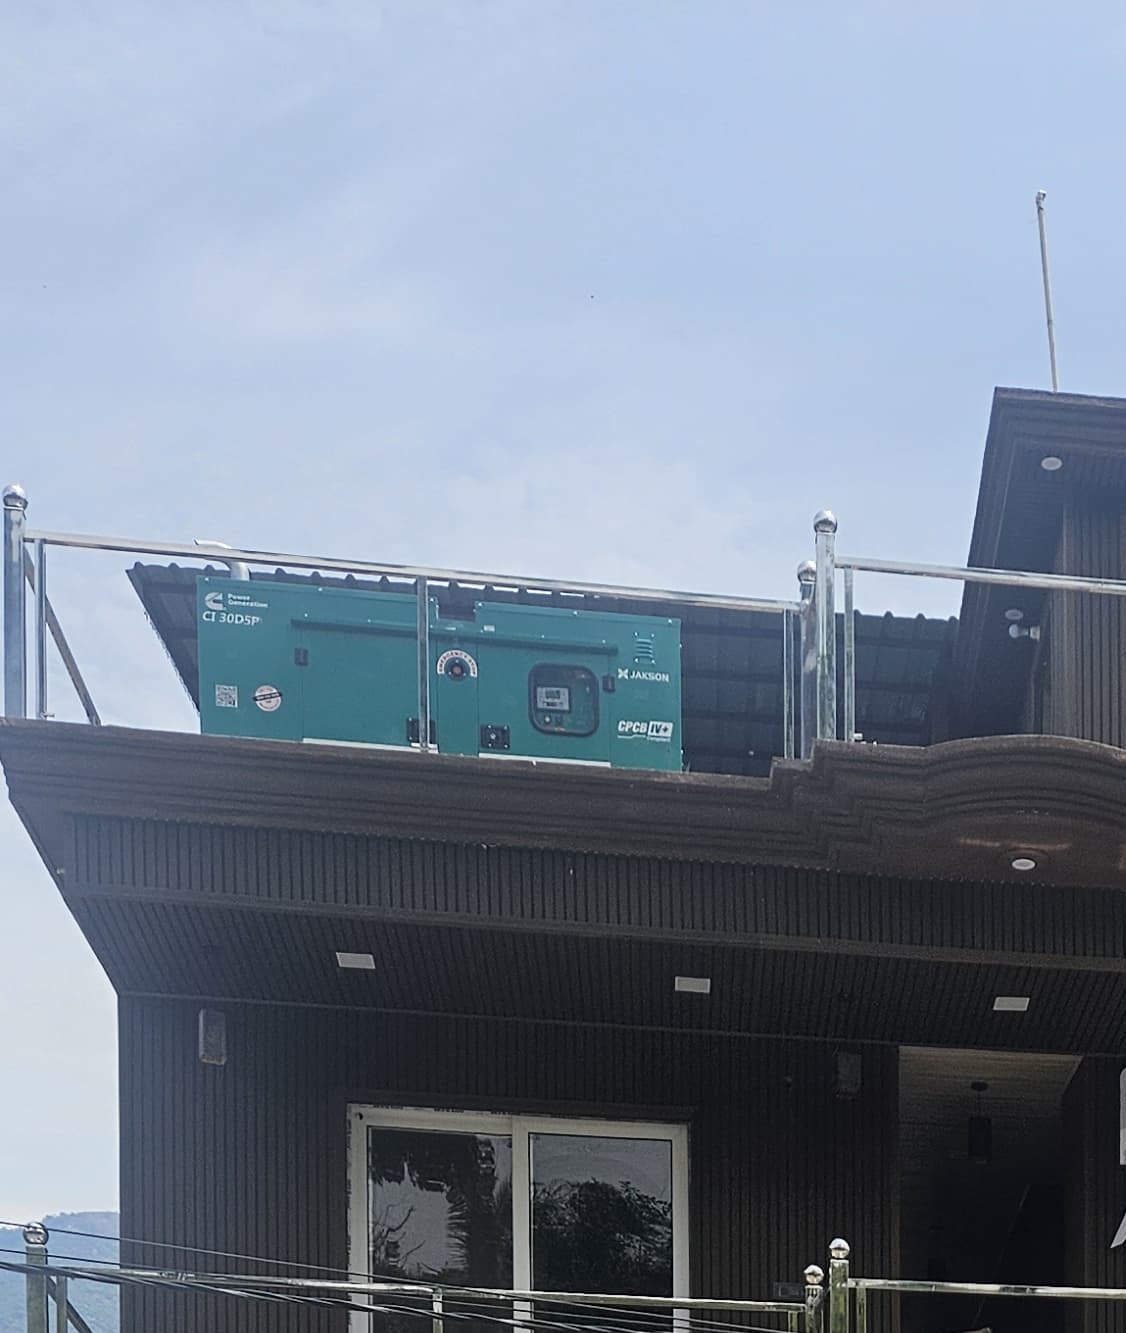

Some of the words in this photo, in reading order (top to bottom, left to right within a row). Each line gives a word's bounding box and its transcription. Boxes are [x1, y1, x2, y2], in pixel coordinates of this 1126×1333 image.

[202, 610, 217, 622] CI
[630, 670, 669, 682] JAKSON
[618, 720, 648, 733] CPCB
